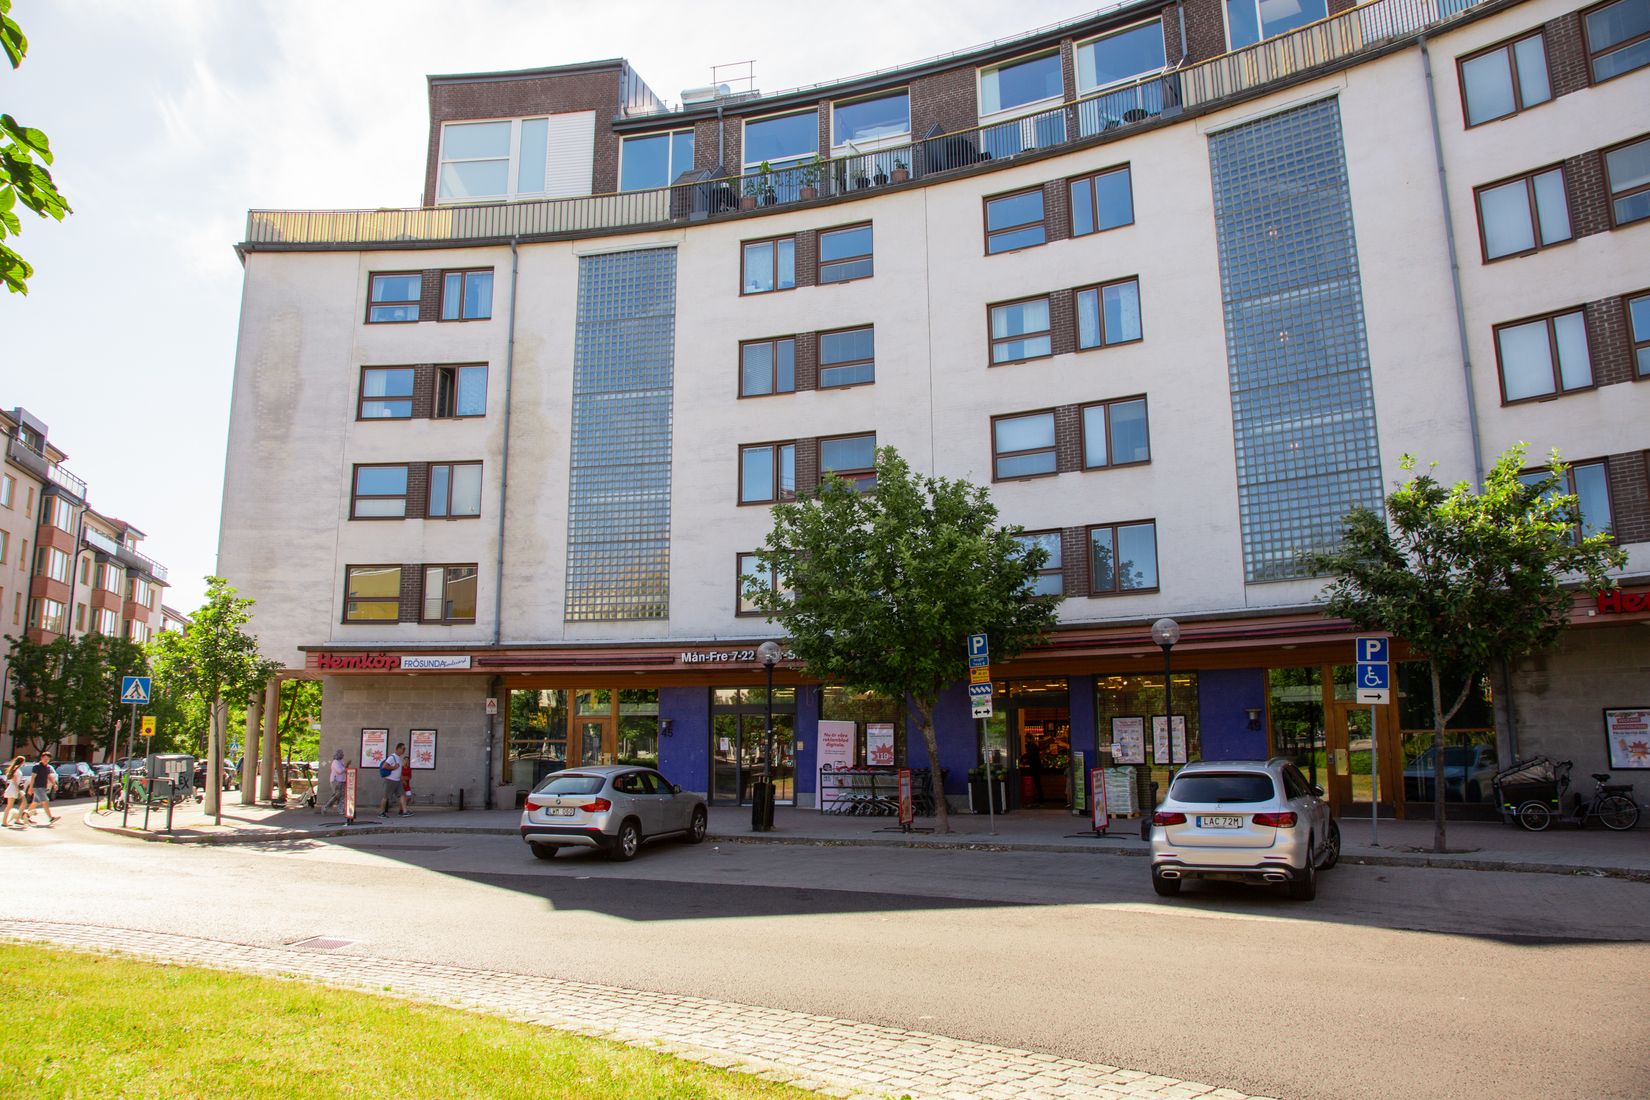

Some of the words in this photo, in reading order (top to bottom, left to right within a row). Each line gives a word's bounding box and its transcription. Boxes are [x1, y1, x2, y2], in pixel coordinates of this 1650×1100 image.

[1598, 588, 1650, 614] He
[972, 636, 984, 655] P
[1366, 639, 1382, 660] P
[317, 652, 401, 671] Hemköp
[403, 658, 445, 668] FRÖSUNDA
[681, 651, 728, 662] Mån-Fre
[732, 650, 755, 661] 7-22
[1203, 817, 1220, 826] LAC
[1222, 817, 1239, 826] 72M
